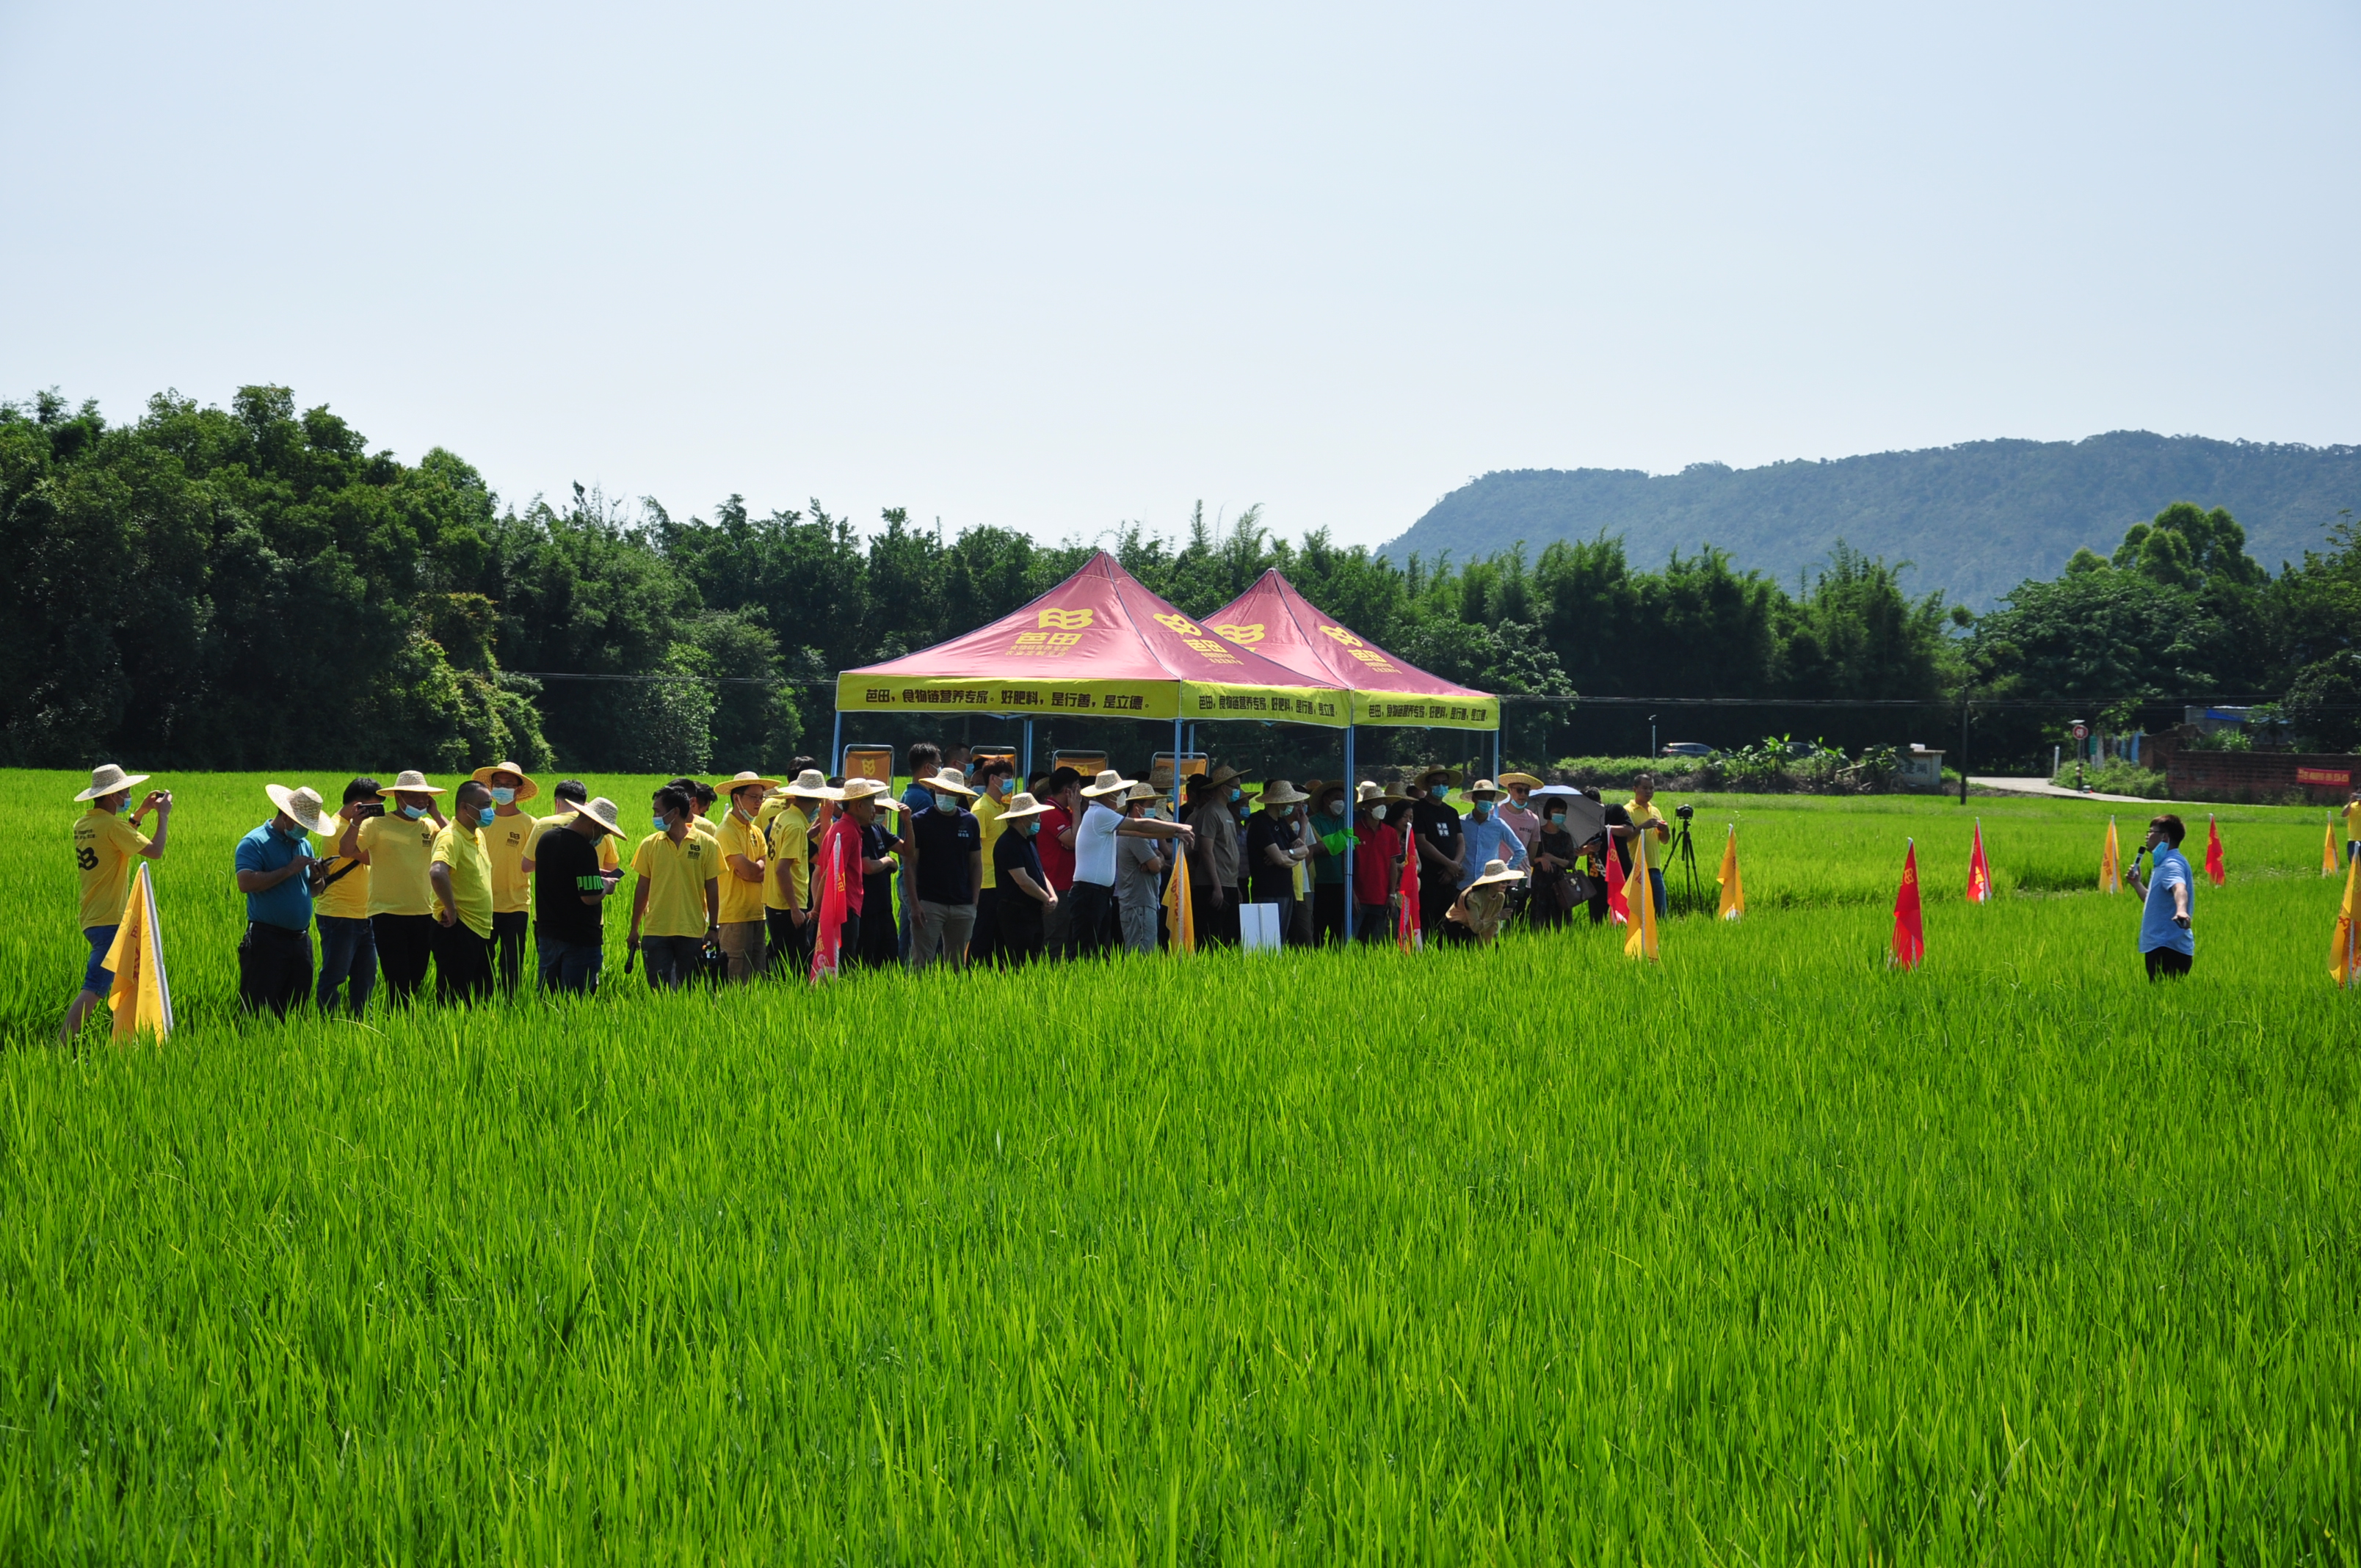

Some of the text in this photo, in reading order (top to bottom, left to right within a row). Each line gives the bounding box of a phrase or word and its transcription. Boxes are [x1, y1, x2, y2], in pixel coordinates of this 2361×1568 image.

[1015, 631, 1084, 646] 芭田
[1182, 639, 1228, 653] 芭田
[1347, 649, 1388, 663] 芭田
[576, 875, 604, 891] PUM
